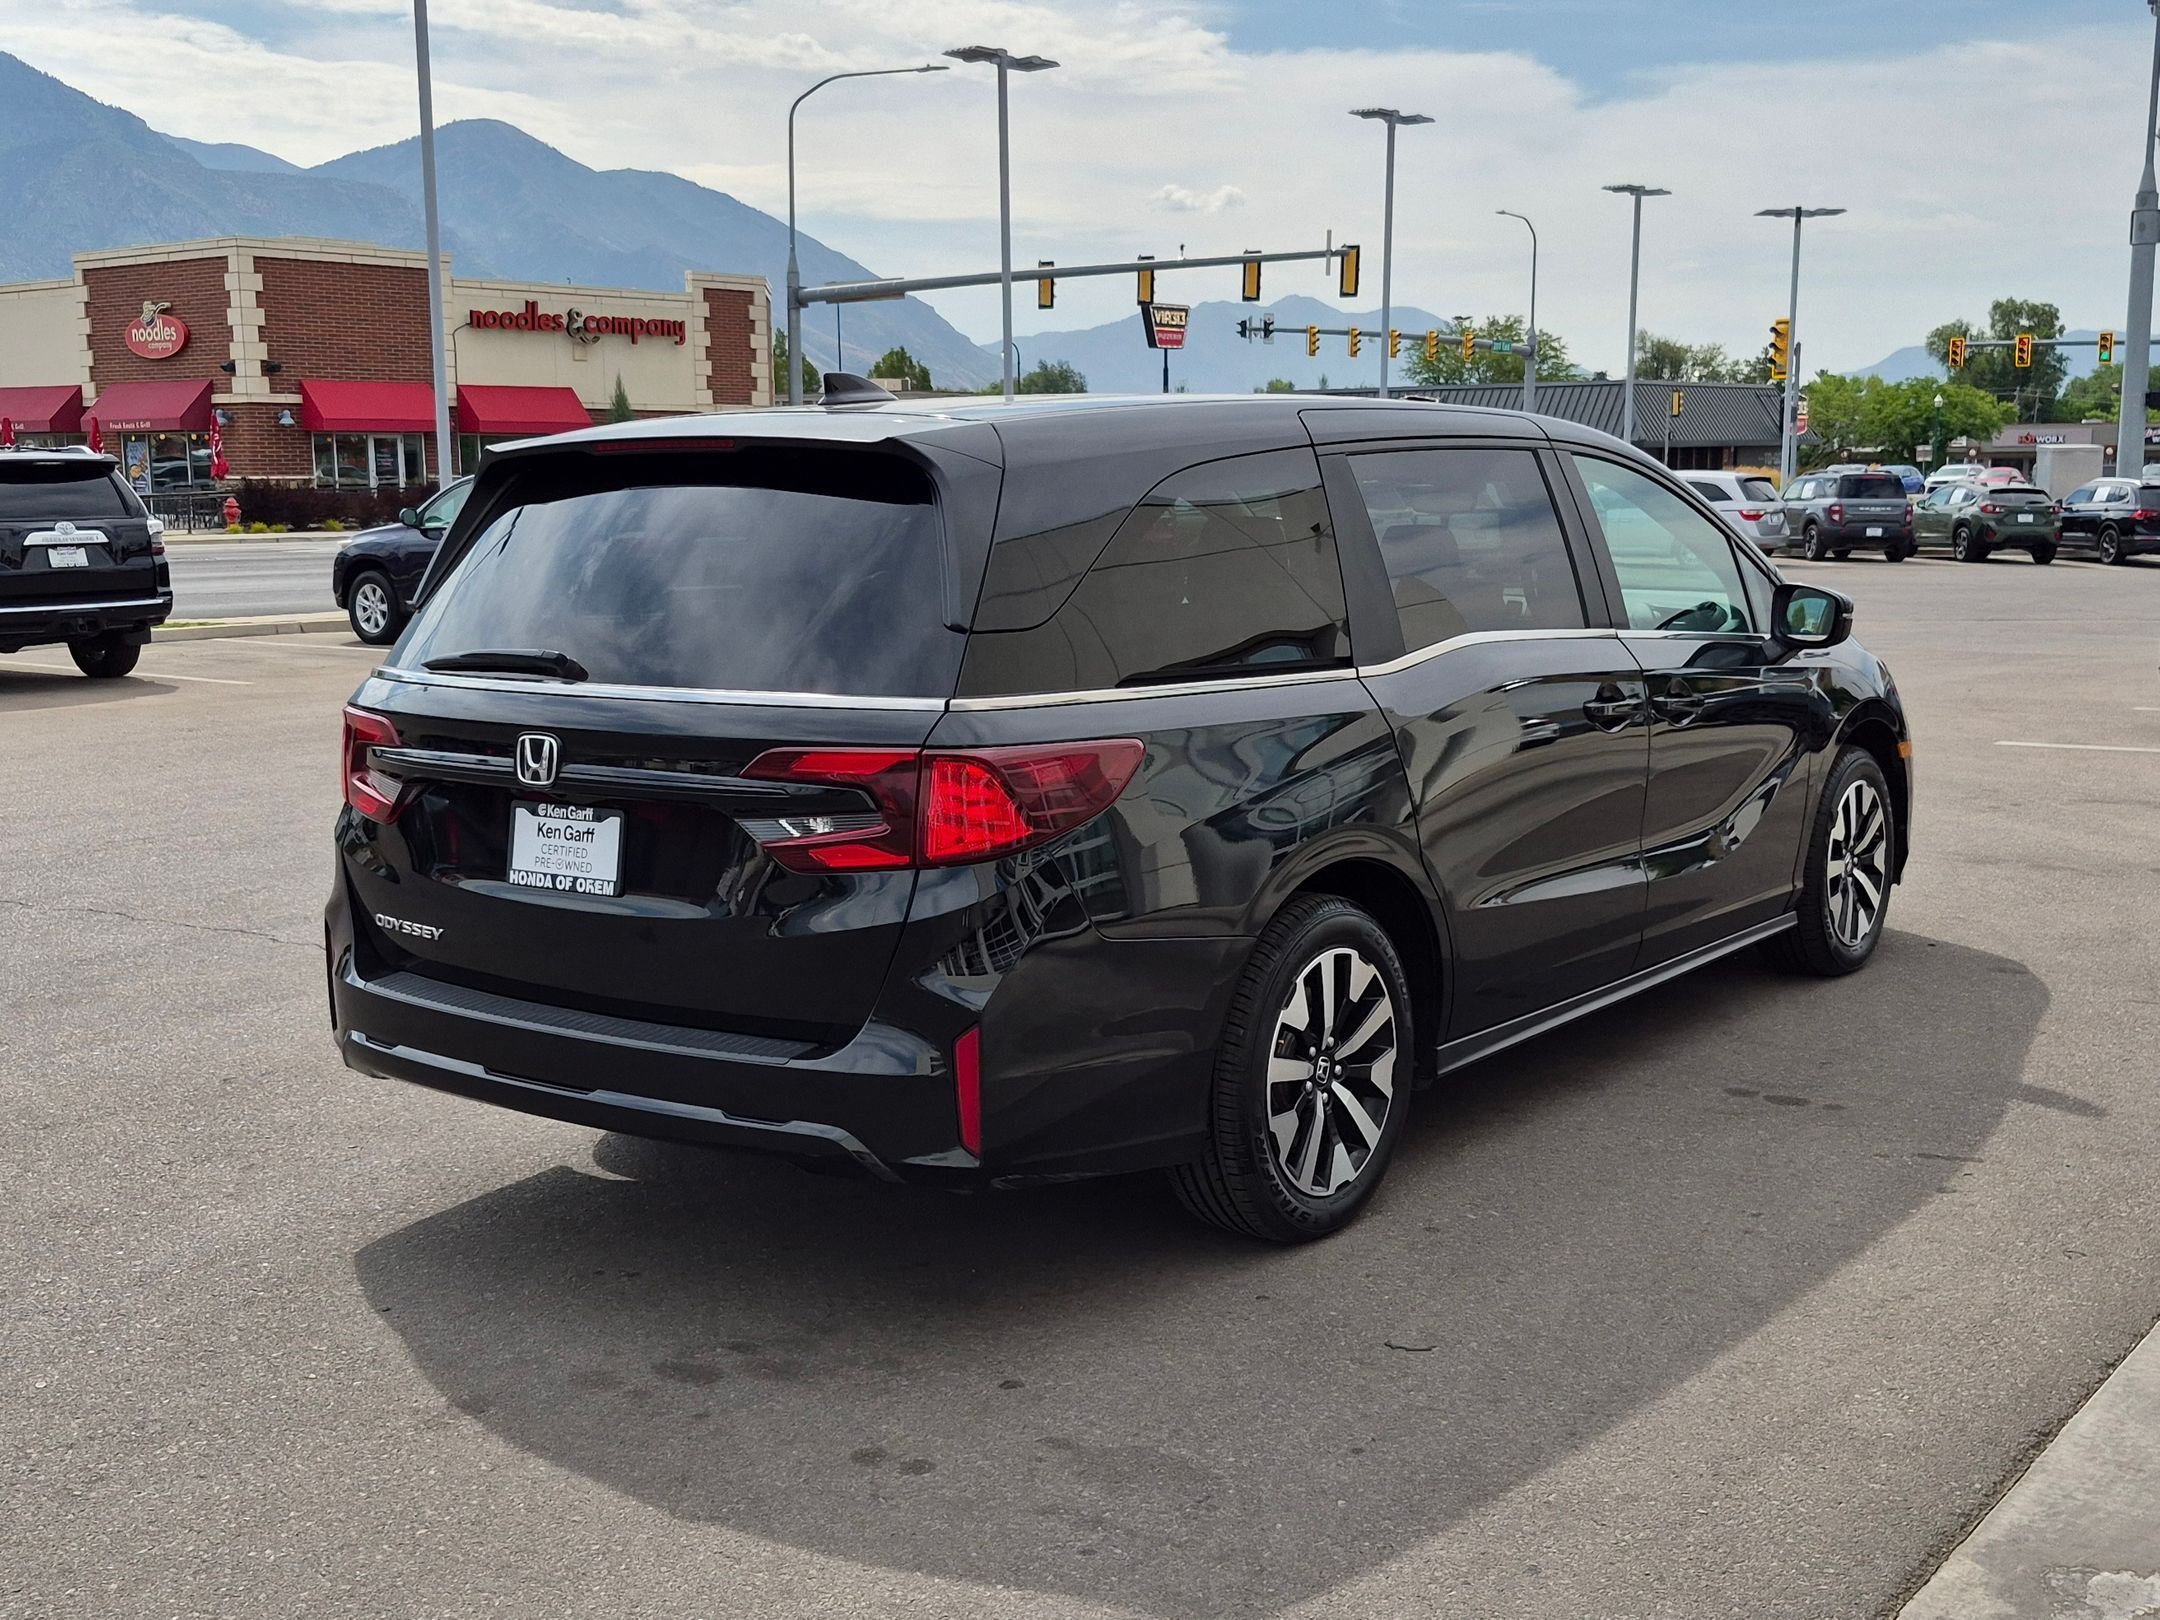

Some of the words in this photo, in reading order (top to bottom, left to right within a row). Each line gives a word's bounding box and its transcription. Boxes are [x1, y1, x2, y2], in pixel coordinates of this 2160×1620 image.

[131, 318, 177, 342] noodles
[469, 300, 565, 332] noodles
[583, 315, 686, 345] company
[546, 803, 567, 818] Ken
[567, 806, 594, 821] Garff
[537, 821, 561, 840] Ken
[563, 825, 595, 843] Garff
[541, 843, 588, 859] CERTIFIED
[535, 856, 592, 873] PRE-OWNED
[509, 870, 553, 889] HONDA
[555, 876, 574, 891] OF
[576, 878, 615, 896] OREM
[375, 913, 444, 940] ODYSSEY
